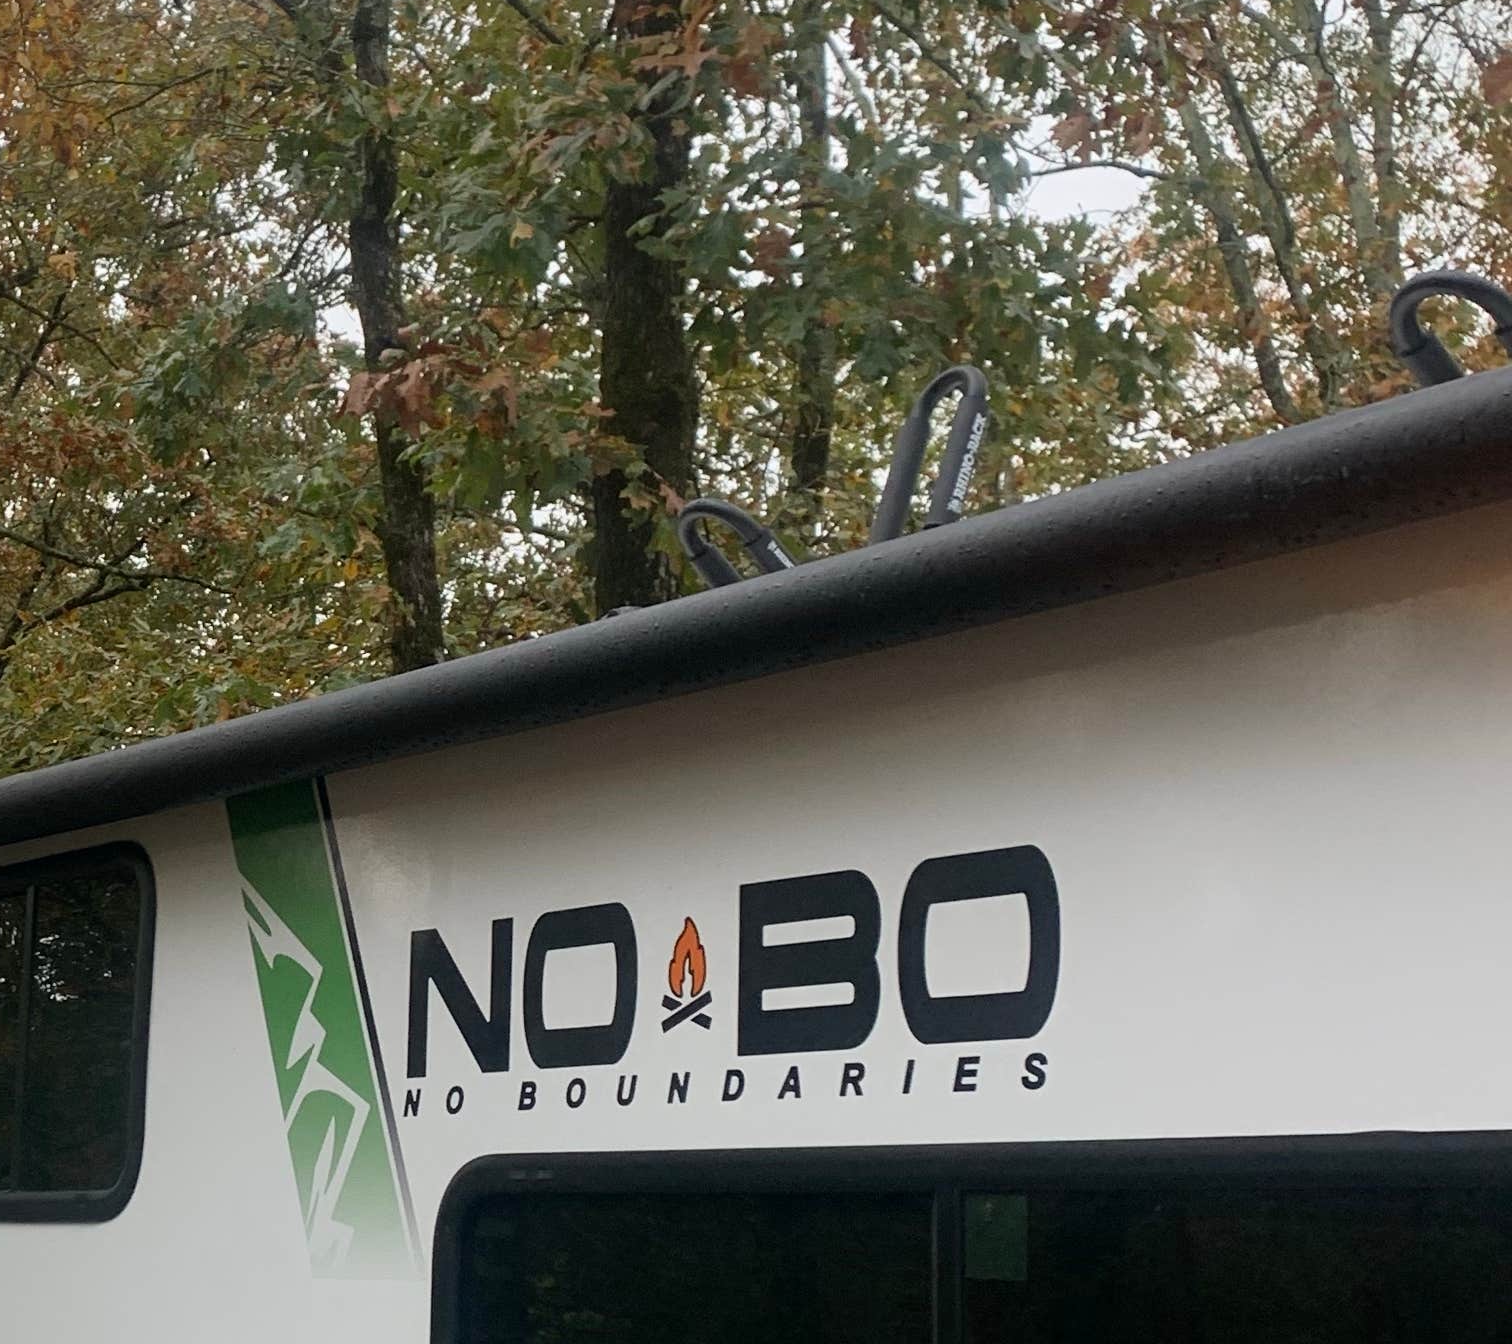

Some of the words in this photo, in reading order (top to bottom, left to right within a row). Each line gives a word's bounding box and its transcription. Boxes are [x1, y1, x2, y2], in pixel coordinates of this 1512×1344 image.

[406, 902, 638, 1078] NO
[737, 844, 1061, 1057] BO
[403, 1086, 465, 1118] NO
[517, 1052, 1050, 1112] BOUNDARIES
